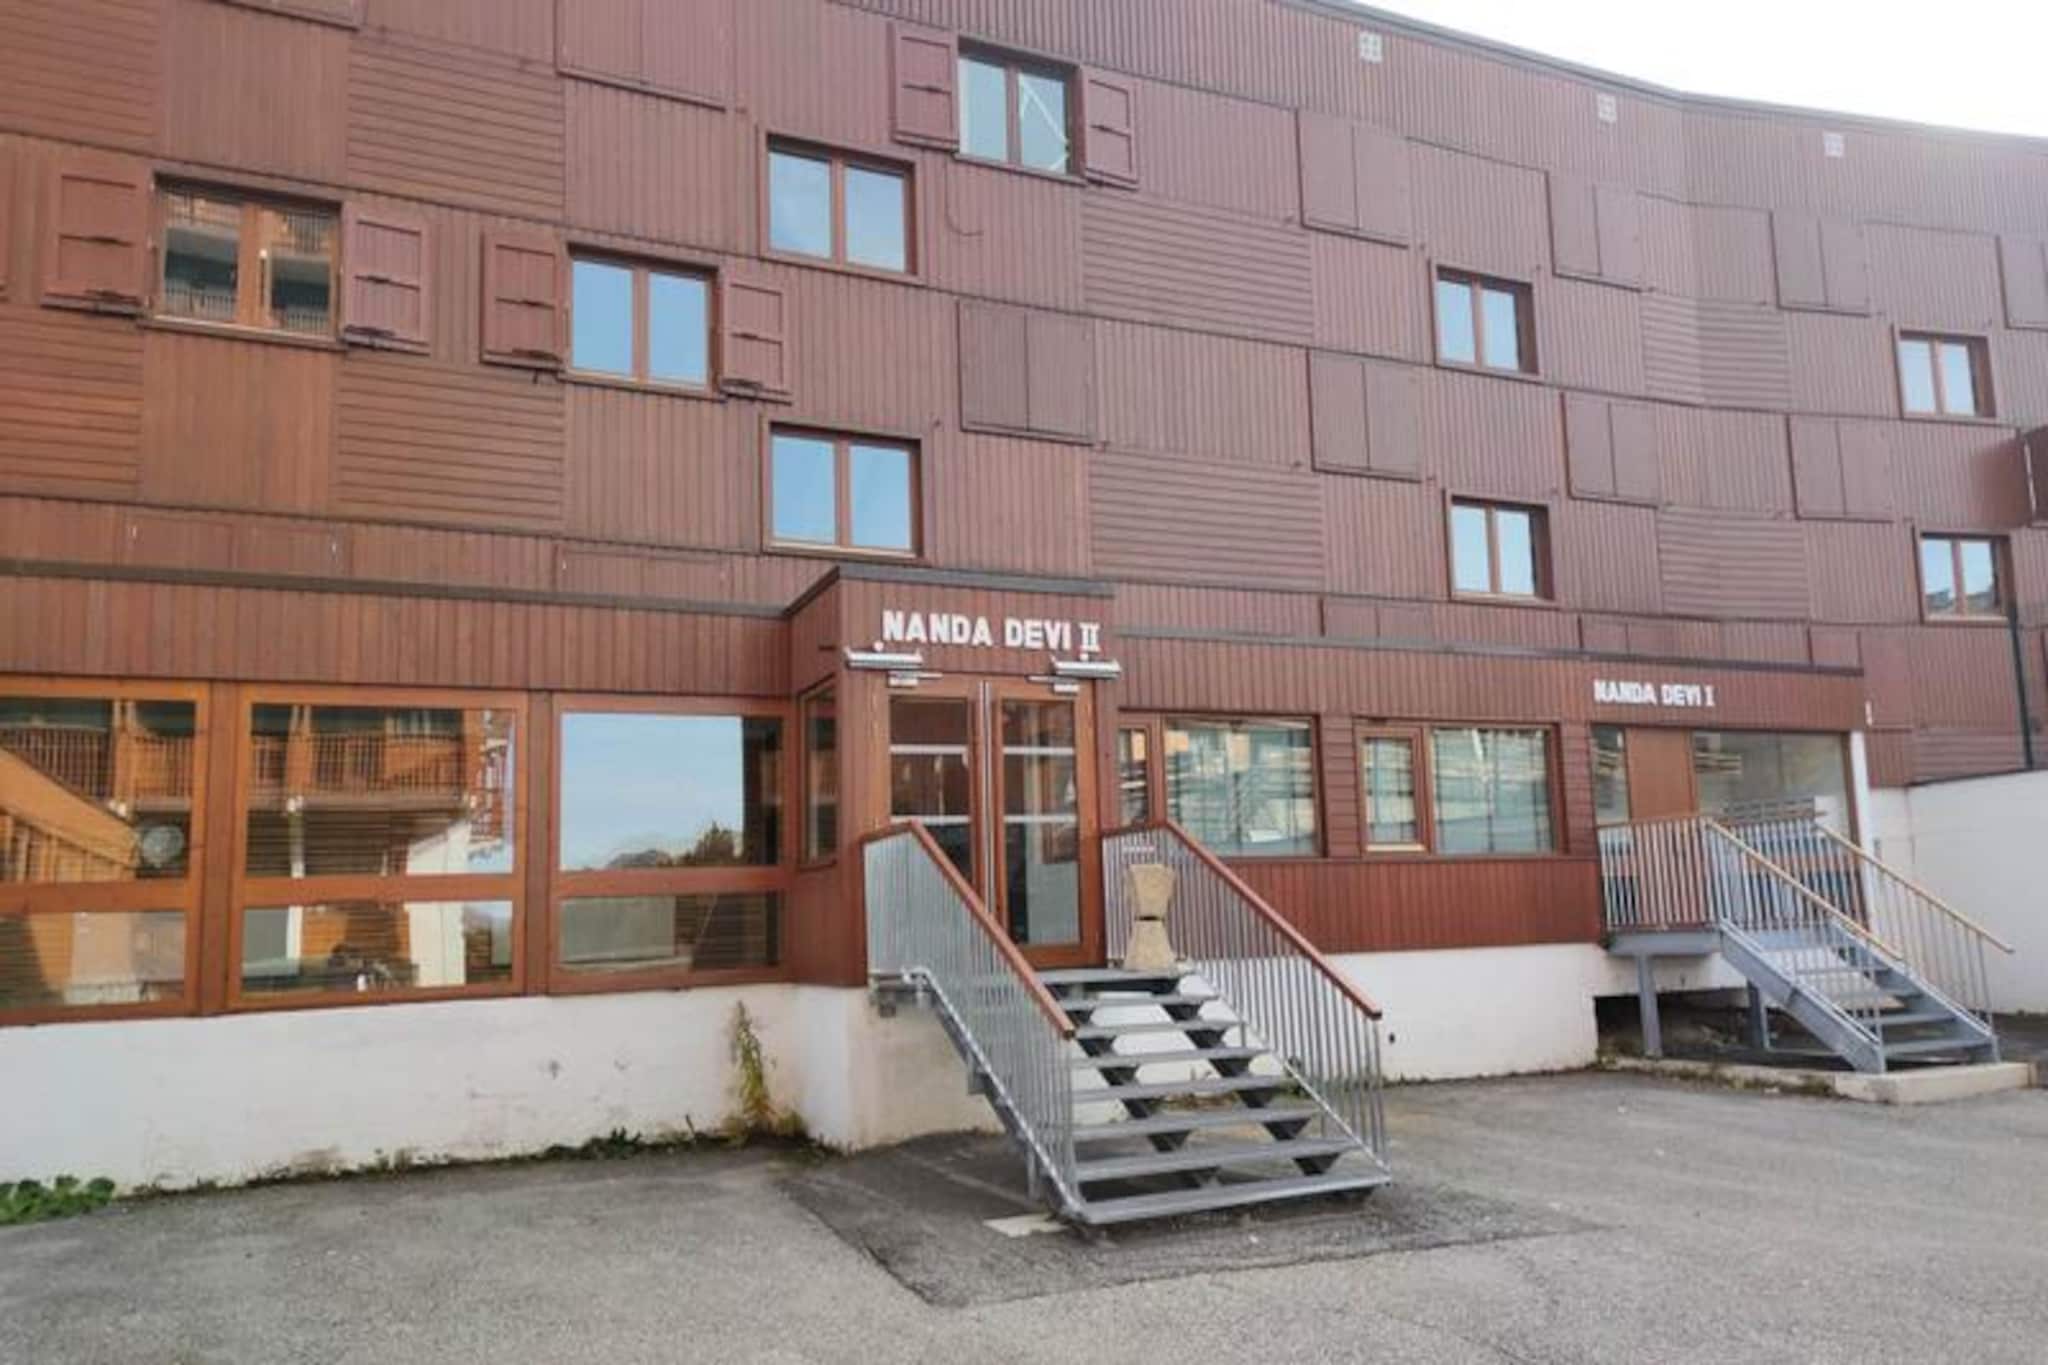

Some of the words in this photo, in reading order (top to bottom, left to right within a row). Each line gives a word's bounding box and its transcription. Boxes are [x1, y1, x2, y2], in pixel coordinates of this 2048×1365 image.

[882, 609, 992, 647] NANDA
[1004, 617, 1071, 650] DEVI
[1079, 621, 1101, 653] II
[1593, 680, 1657, 706] NANDA
[1661, 684, 1701, 707] DEVI
